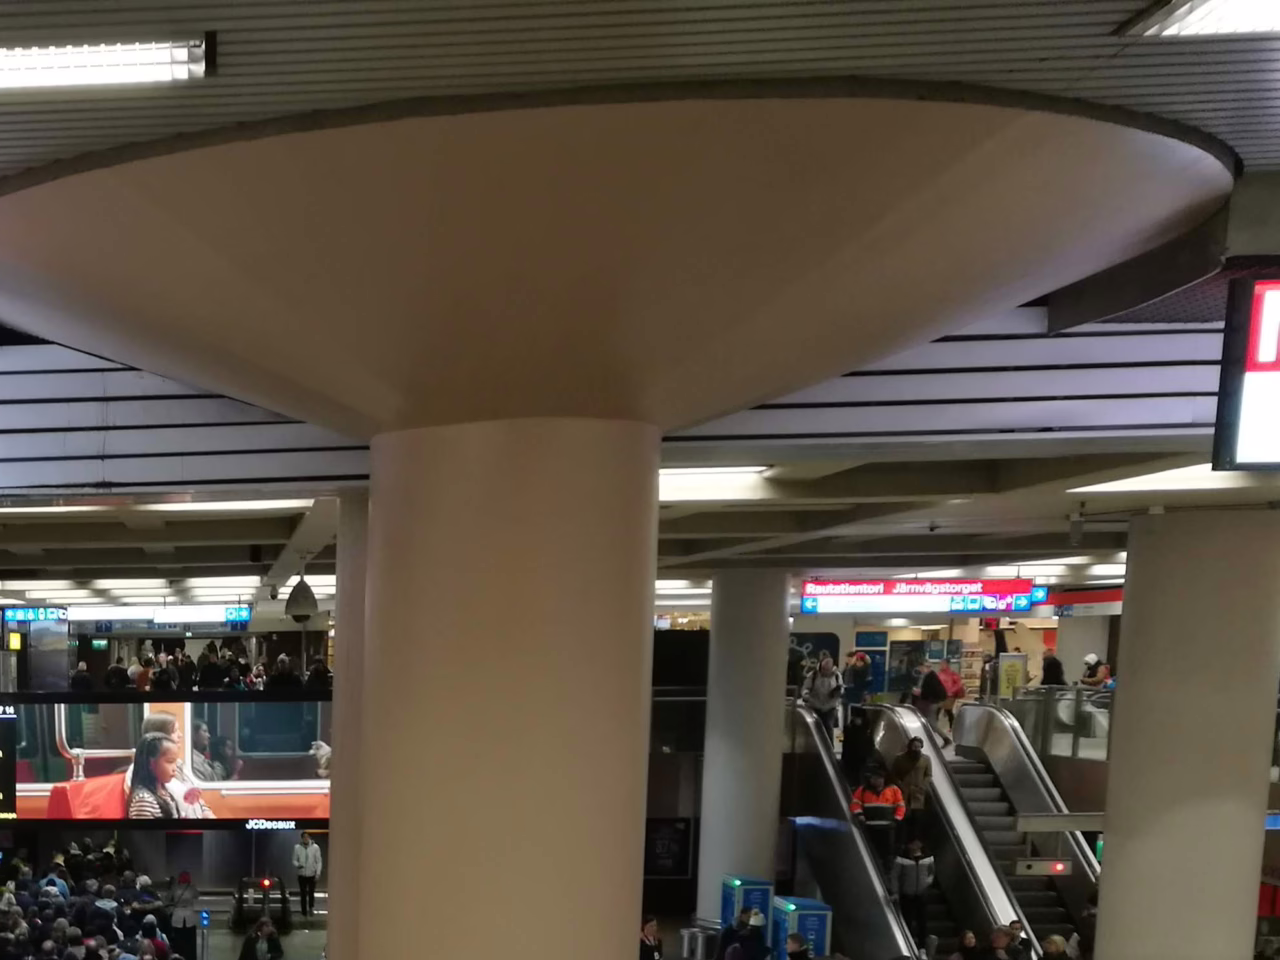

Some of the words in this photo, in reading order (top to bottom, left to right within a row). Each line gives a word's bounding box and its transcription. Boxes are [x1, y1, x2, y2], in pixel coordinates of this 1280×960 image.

[805, 583, 884, 594] Rautatientori
[892, 582, 983, 594] Järnvägstorget
[245, 819, 296, 829] JCDecaux
